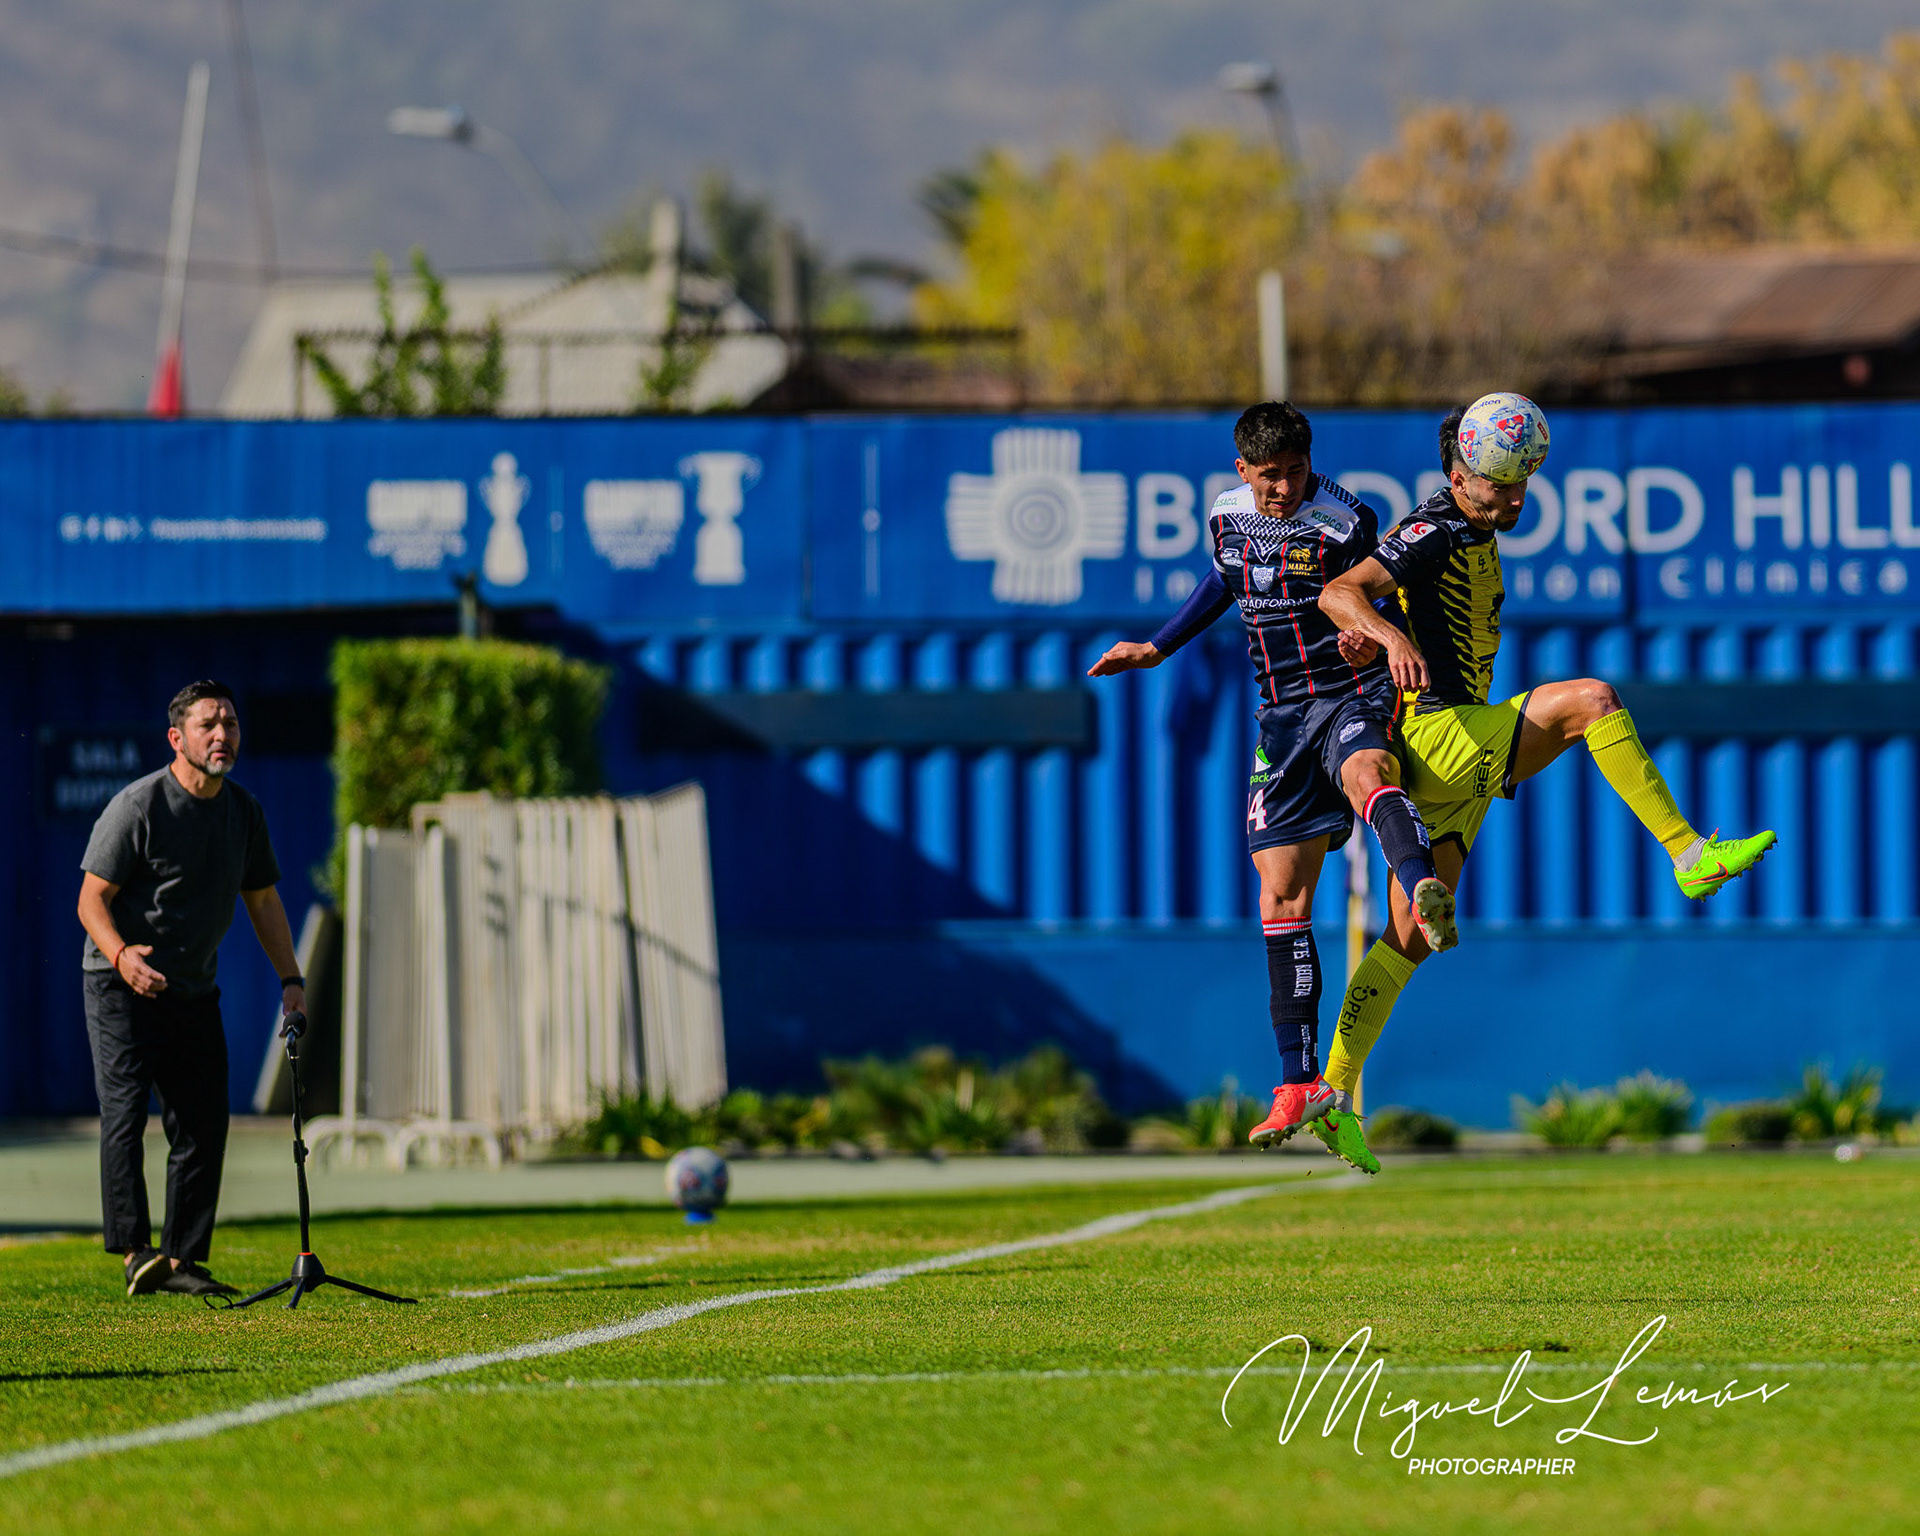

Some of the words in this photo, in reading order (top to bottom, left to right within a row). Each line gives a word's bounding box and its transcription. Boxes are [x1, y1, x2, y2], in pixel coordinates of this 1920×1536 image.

[1732, 462, 1920, 551] HILL
[1287, 563, 1319, 572] MARLEY
[1247, 788, 1268, 835] 4
[1339, 985, 1369, 1037] OPEN
